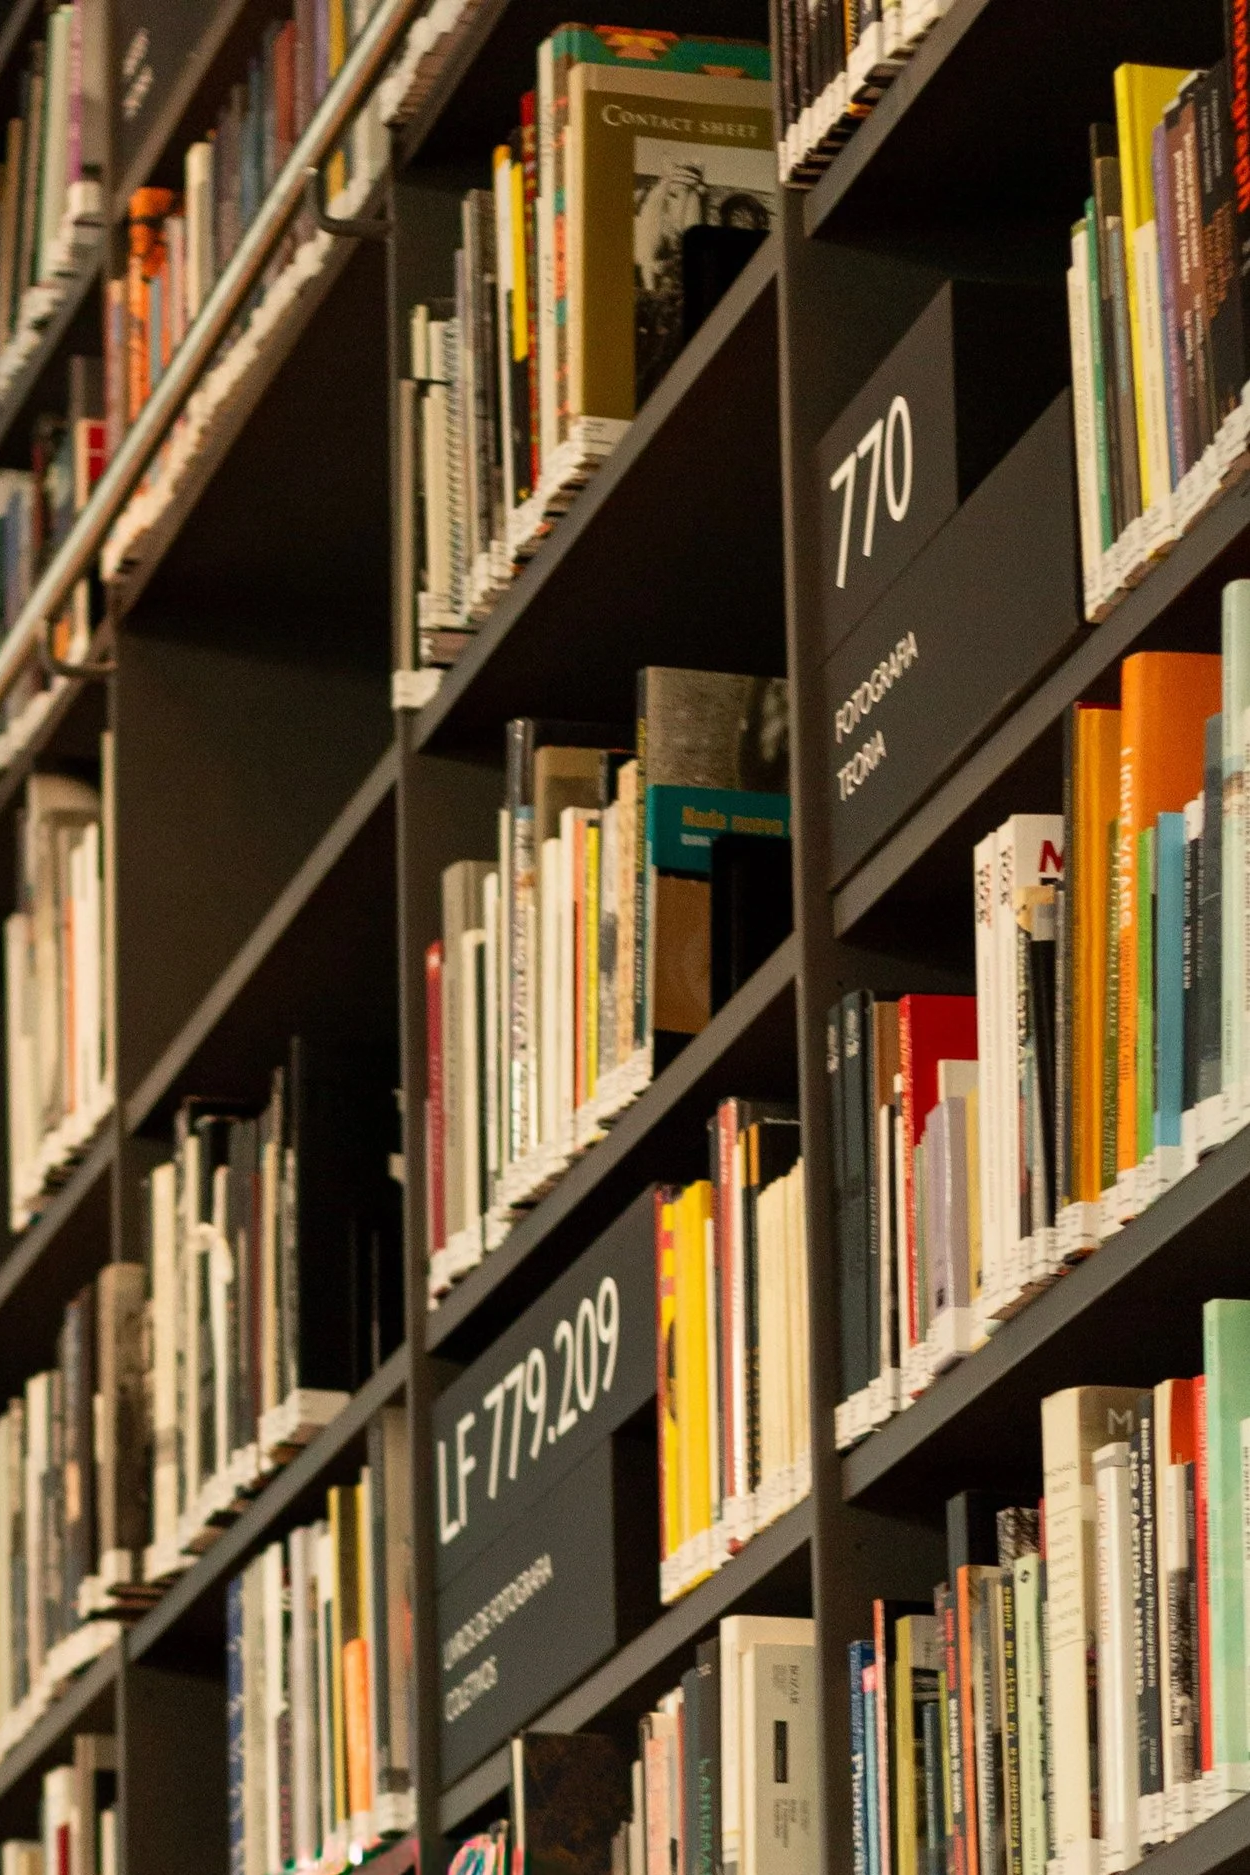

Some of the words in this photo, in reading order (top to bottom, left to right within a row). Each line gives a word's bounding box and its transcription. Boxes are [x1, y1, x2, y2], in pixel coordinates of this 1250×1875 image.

[602, 104, 694, 133] CONTACT
[700, 120, 759, 139] SHEET
[830, 396, 913, 588] 770
[836, 631, 919, 744] FOTOGRAFIA
[837, 730, 887, 801] TEORIA
[437, 1412, 476, 1544] LF
[483, 1276, 620, 1499] 779.209
